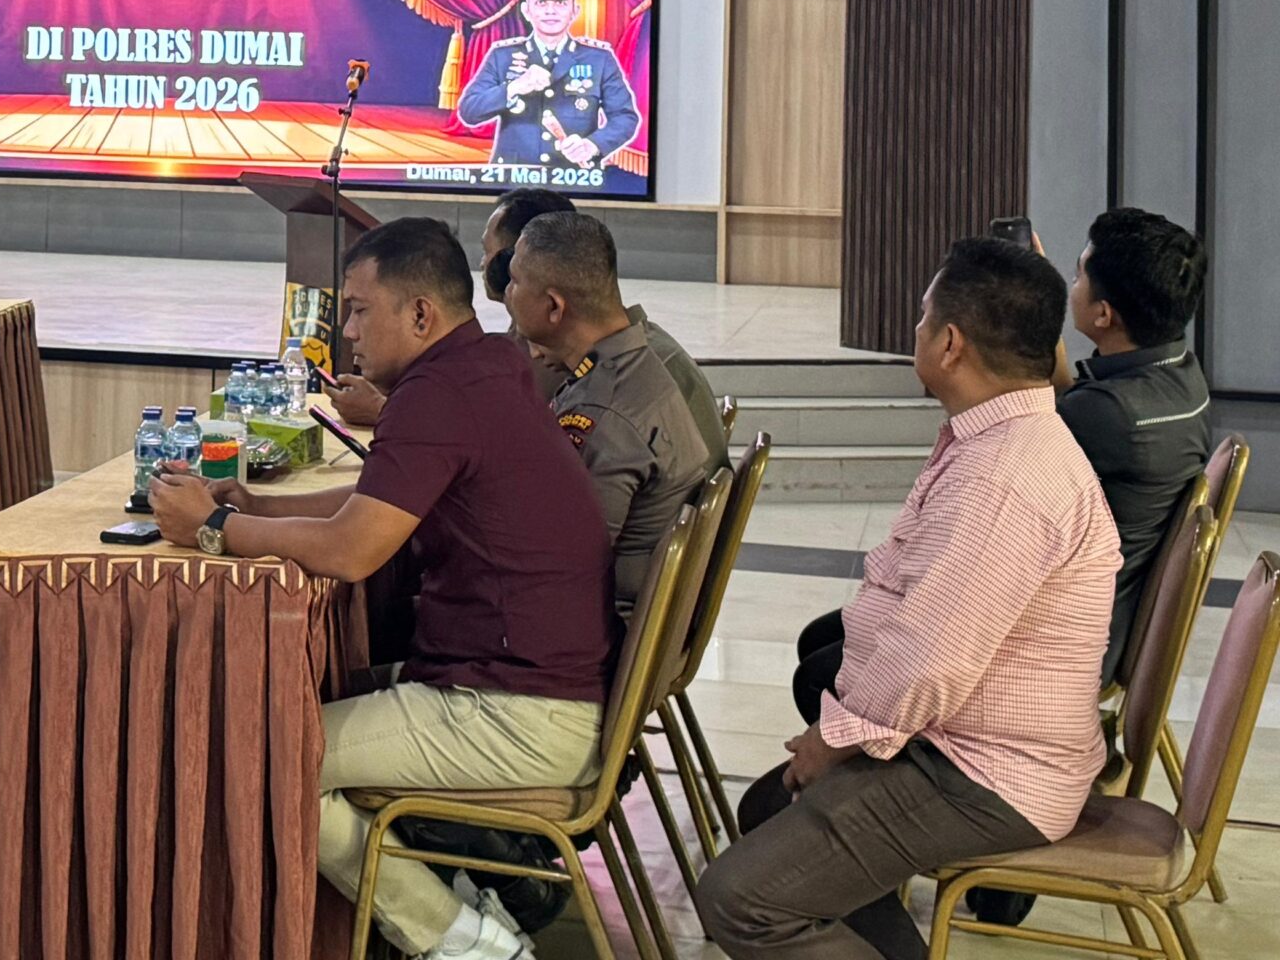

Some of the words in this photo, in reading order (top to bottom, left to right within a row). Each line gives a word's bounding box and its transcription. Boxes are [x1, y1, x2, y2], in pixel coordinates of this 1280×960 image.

[25, 26, 64, 60] DI
[71, 27, 192, 64] POLRES
[200, 29, 304, 66] DUMAI
[66, 73, 167, 109] TAHUN
[174, 76, 261, 112] 2026
[406, 163, 476, 185] Dumai,
[481, 168, 504, 183] 21
[510, 167, 548, 185] Mei
[551, 168, 604, 186] 2026
